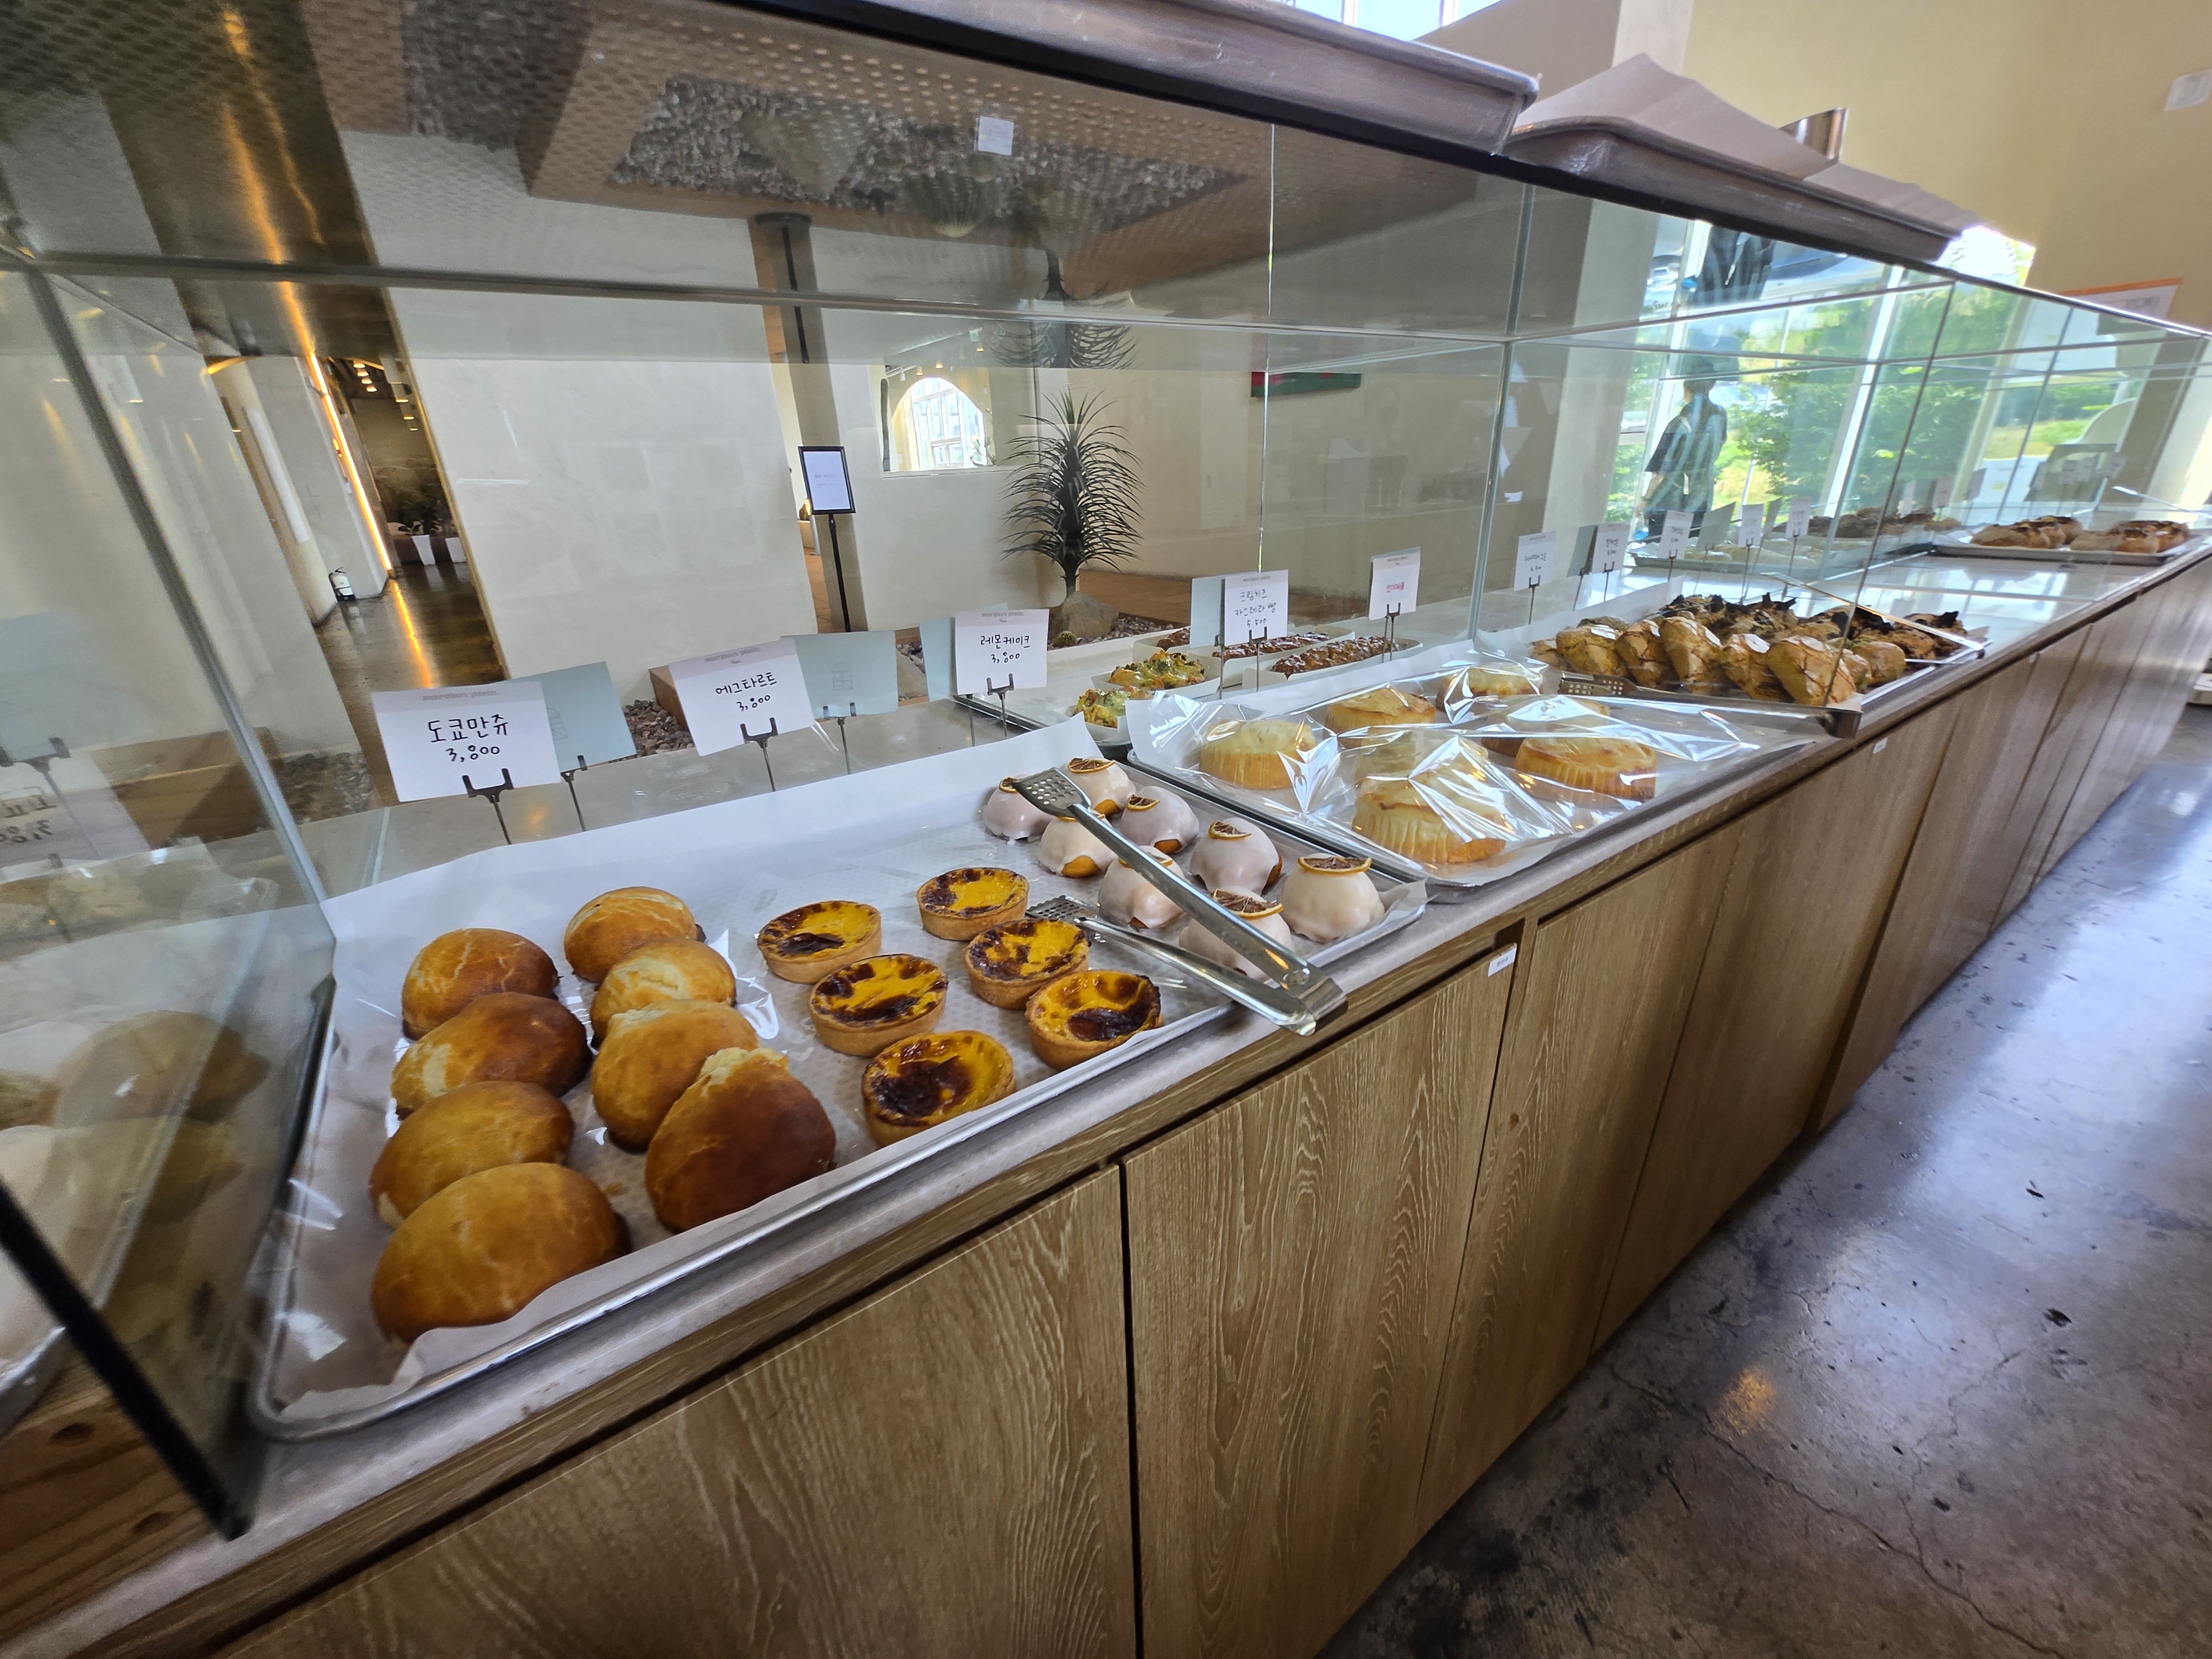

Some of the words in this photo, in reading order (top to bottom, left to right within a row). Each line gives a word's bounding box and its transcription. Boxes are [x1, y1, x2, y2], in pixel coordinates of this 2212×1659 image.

[1240, 589, 1267, 602] 크림치즈
[980, 634, 1030, 649] 레몬케이크
[990, 651, 1020, 664] 3,800
[716, 671, 778, 695] 에그타르트
[736, 694, 771, 712] 3,800
[427, 714, 509, 743] 도쿄만쥬
[445, 745, 500, 762] 3,800
